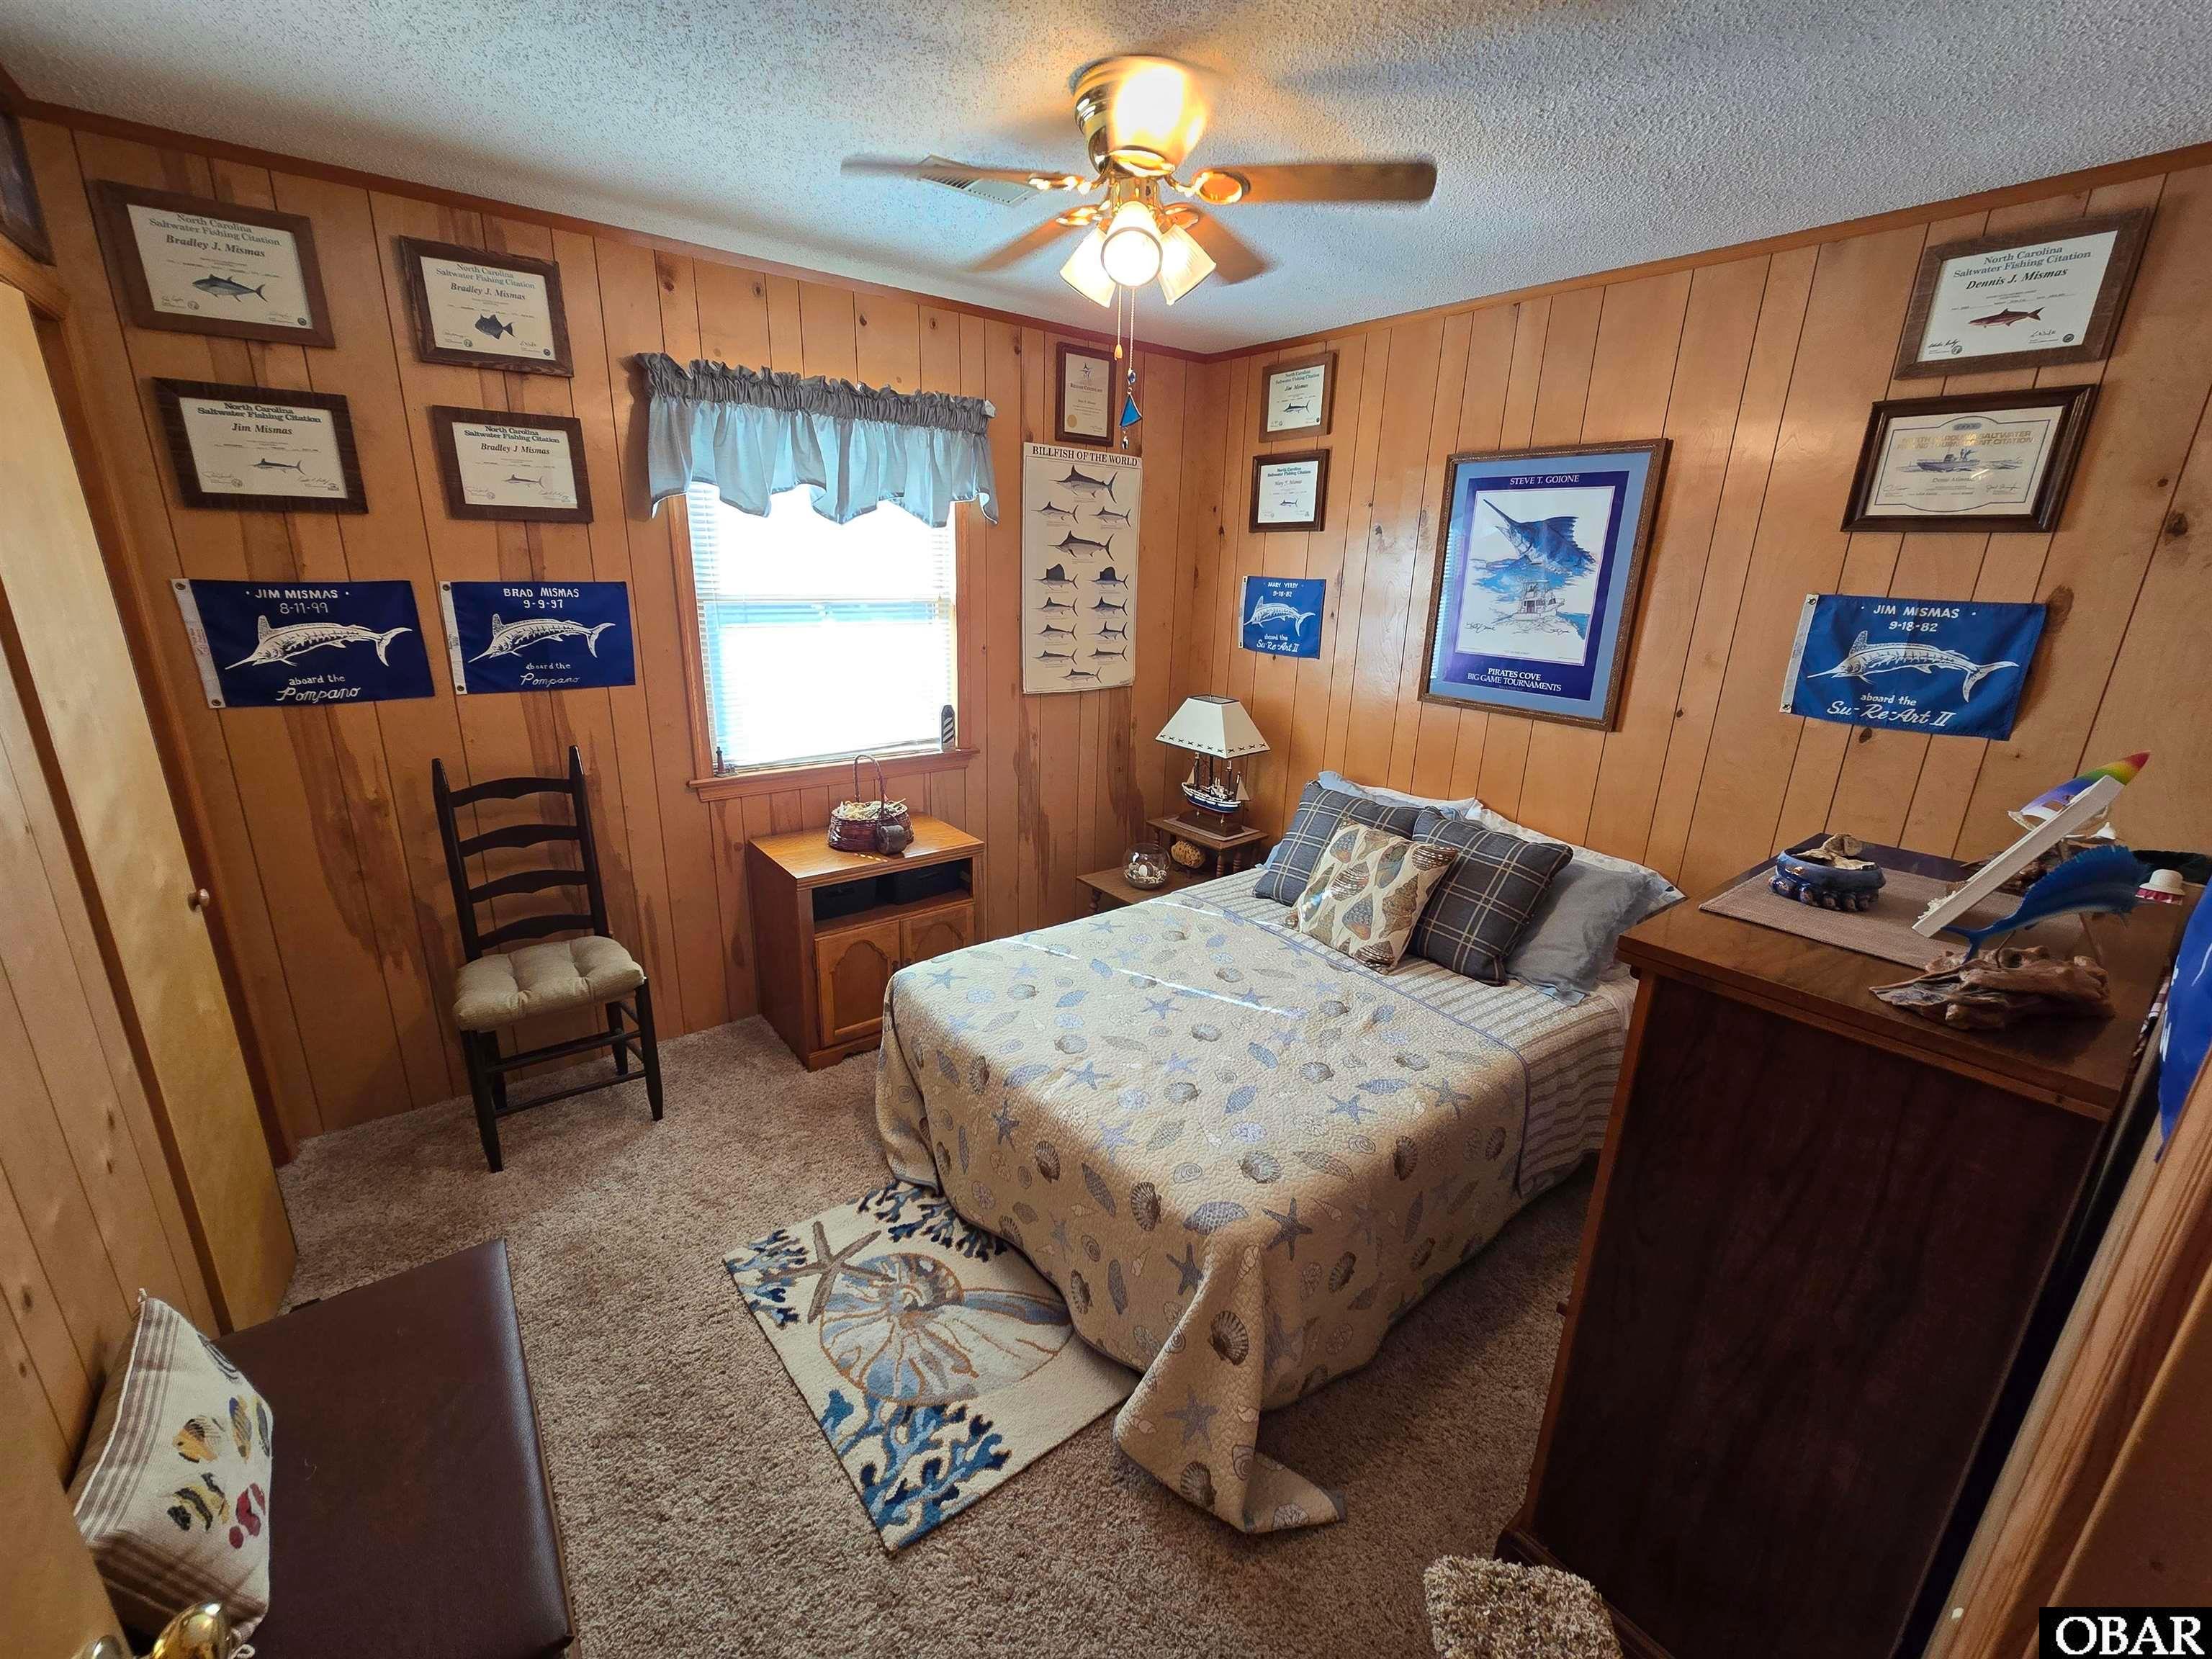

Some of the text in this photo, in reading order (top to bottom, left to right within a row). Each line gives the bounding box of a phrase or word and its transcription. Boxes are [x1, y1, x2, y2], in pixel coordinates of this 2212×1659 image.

[177, 213, 252, 233] North Carolina
[149, 218, 281, 246] Saltwater Fishing Citation
[166, 235, 265, 257] Bradley J. Mismas
[1983, 246, 2062, 264] North Carolina
[457, 264, 513, 279] North Carolina
[1954, 251, 2091, 278] Saltwater Fishing Citation
[436, 268, 535, 289] Saltwater Fishing Citation
[1966, 269, 2068, 289] Dennis J. Mismas
[451, 282, 482, 296] Bradley
[495, 289, 526, 300] Mismas
[197, 407, 321, 423] Saltwater Fishing Citation
[224, 403, 294, 414] North Carolina
[232, 423, 292, 435] Jim Mismas
[464, 430, 501, 439] Saltwater
[503, 433, 531, 442] Fishing
[481, 443, 511, 453] Bradley
[521, 446, 549, 454] Mismas
[1033, 446, 1138, 467] BILLFISH OF THE WORLD
[1510, 475, 1580, 485] STEVE T. GOIONE
[255, 589, 338, 599] JIM MISMAS
[503, 587, 580, 598] BRAD MISMAS
[279, 602, 329, 614] 8-11-99
[523, 599, 563, 609] 9-9-97
[1874, 605, 1960, 619] JIM MISMAS
[1889, 621, 1938, 632] 9-18-82
[525, 662, 554, 670] aboard
[289, 673, 346, 685] aboard the
[520, 673, 580, 688] Pompano
[1488, 667, 1542, 681] PIRATES COVE
[1467, 673, 1480, 681] BIG
[1480, 674, 1502, 684] GAME
[1503, 677, 1562, 692] TOURNAMENTS
[275, 686, 361, 703] Pompano
[1860, 693, 1917, 706] aboard the
[1929, 711, 1956, 727] II
